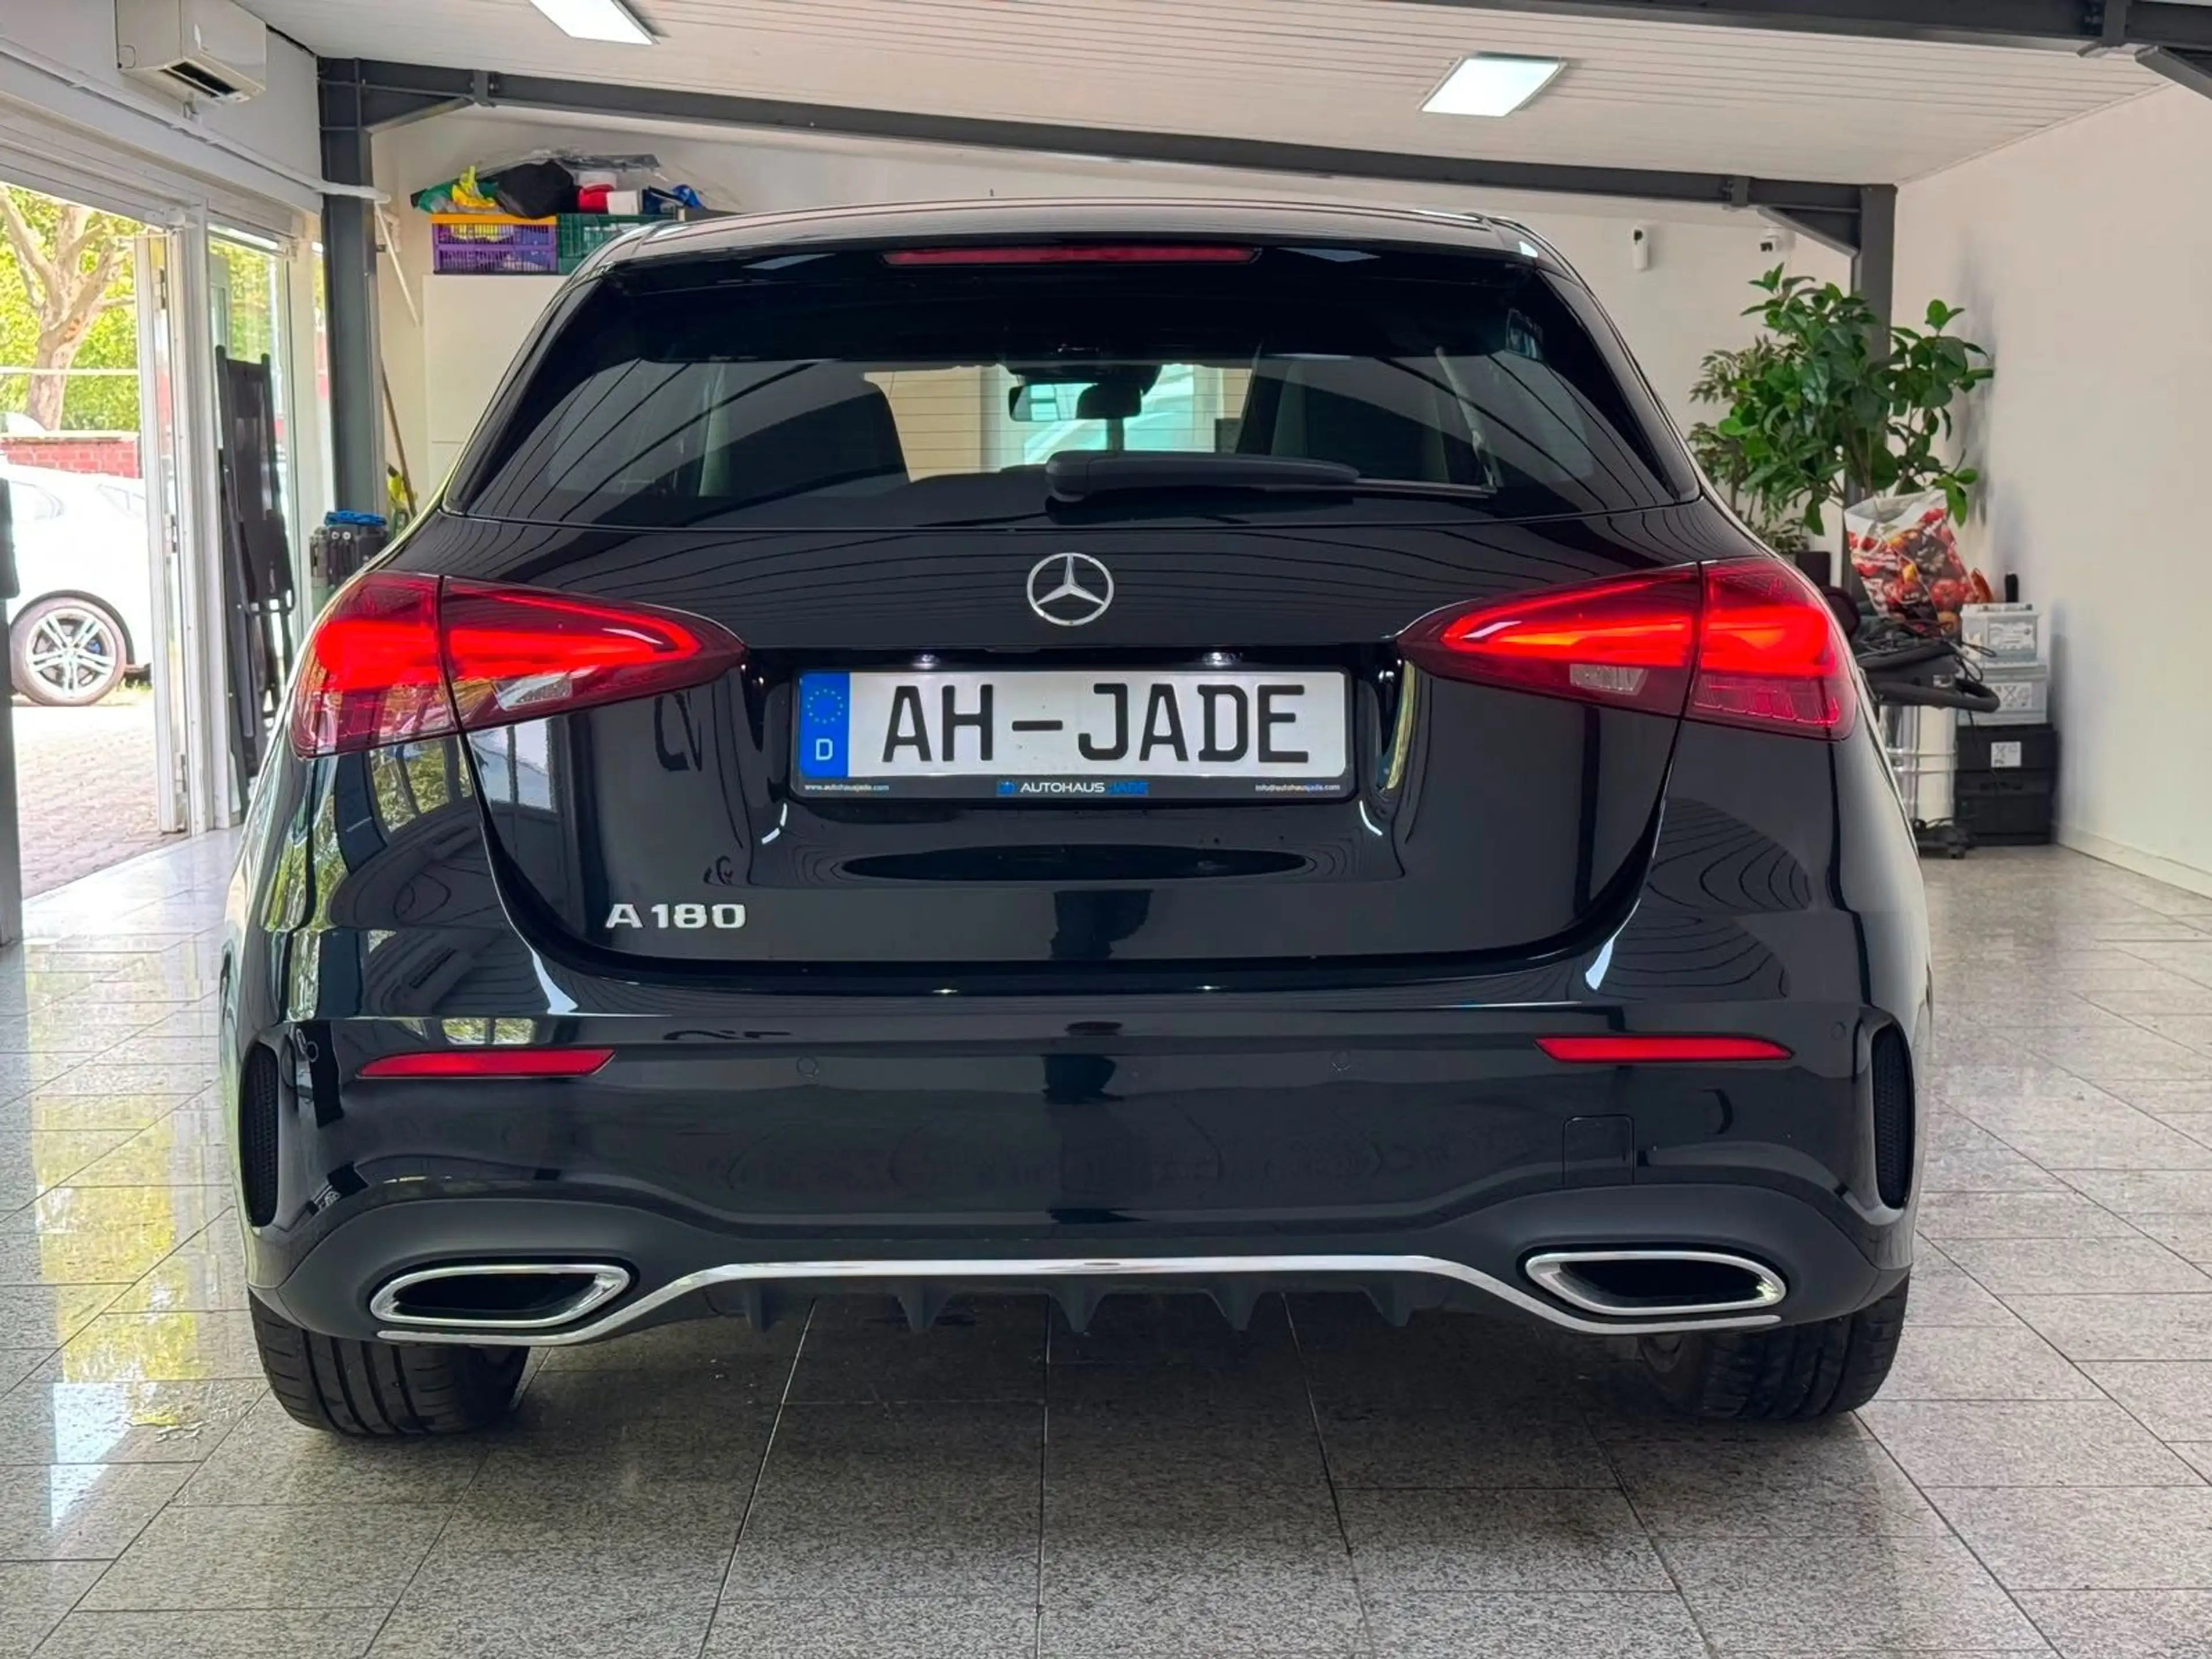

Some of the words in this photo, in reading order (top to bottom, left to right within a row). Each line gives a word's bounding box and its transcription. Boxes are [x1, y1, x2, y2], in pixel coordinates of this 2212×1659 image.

[815, 738, 833, 761] D
[1019, 782, 1105, 793] AUTOHAUS
[605, 903, 644, 929] A
[651, 903, 747, 929] 180
